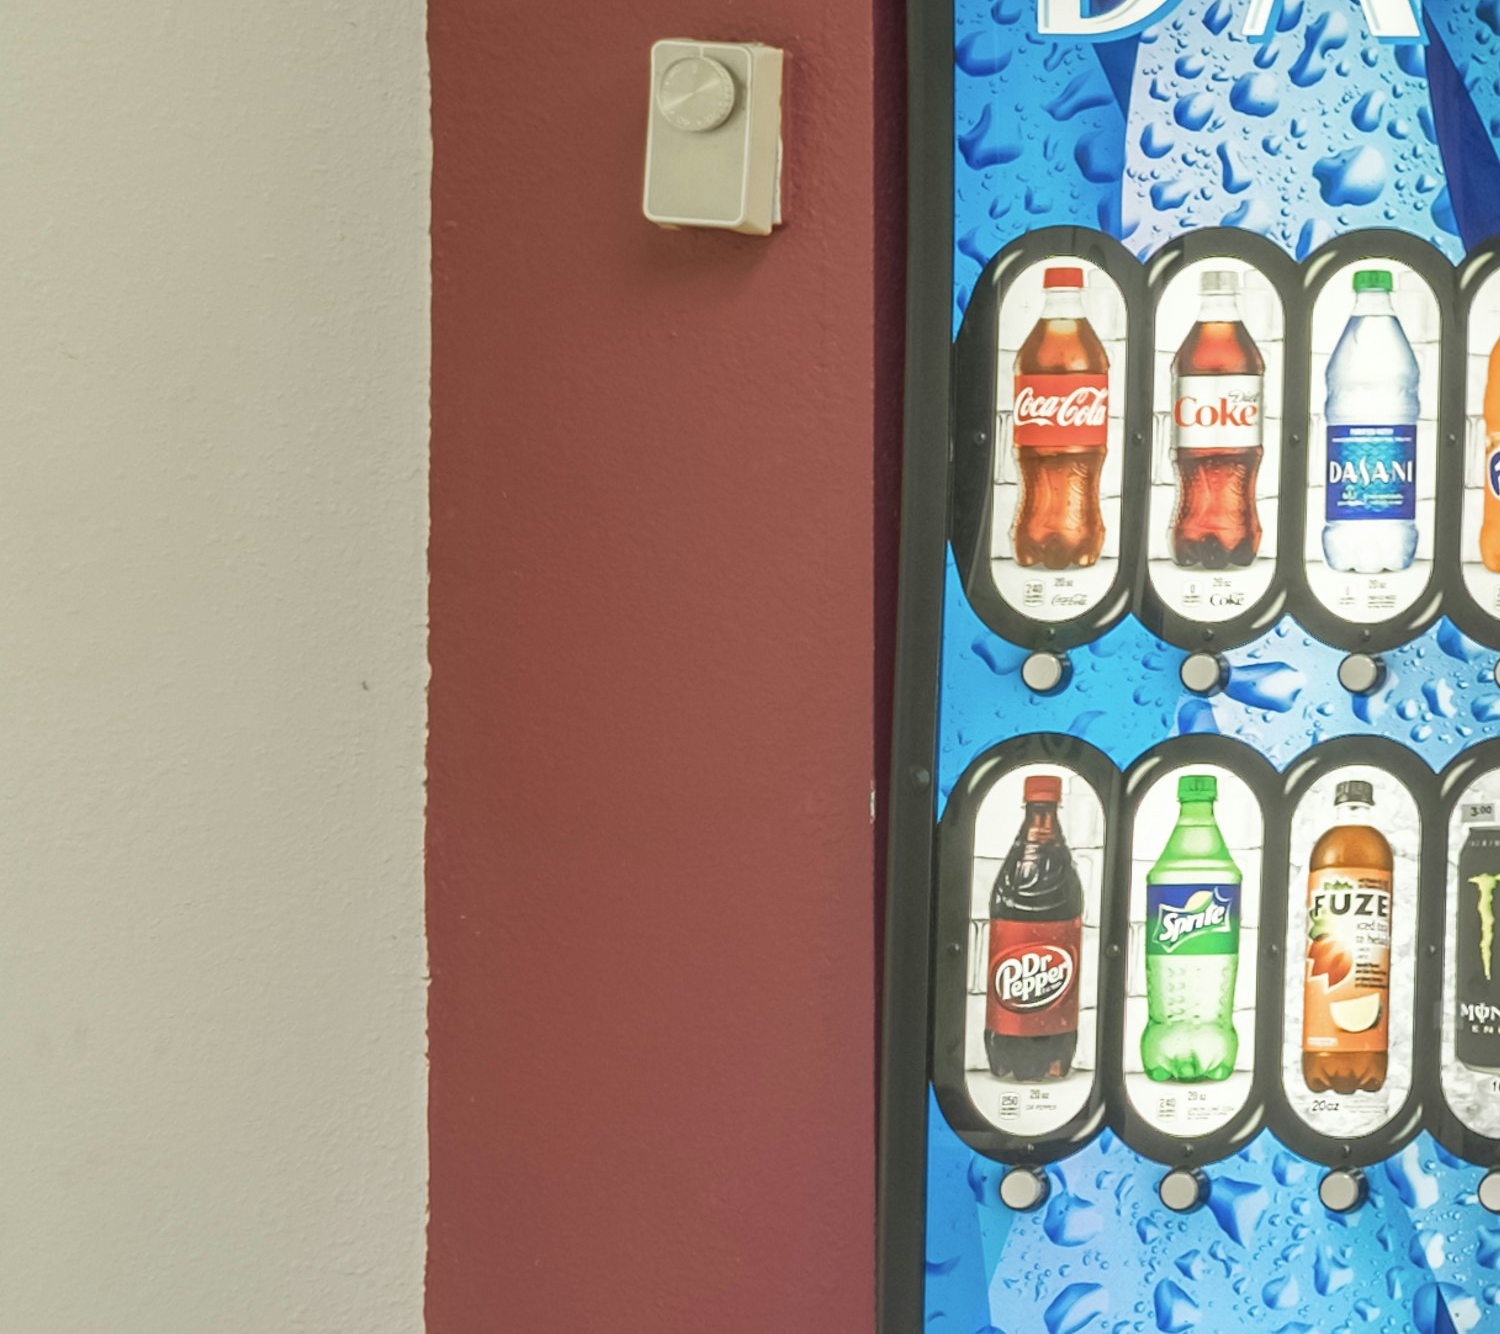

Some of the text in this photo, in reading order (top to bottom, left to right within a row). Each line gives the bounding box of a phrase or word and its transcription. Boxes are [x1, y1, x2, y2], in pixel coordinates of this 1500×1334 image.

[1174, 395, 1258, 428] Coke
[1329, 455, 1412, 486] DASANI
[1314, 893, 1389, 917] FUZE
[1159, 903, 1225, 942] Sprite
[1000, 957, 1069, 1001] Pepper
[1023, 952, 1052, 979] Dr
